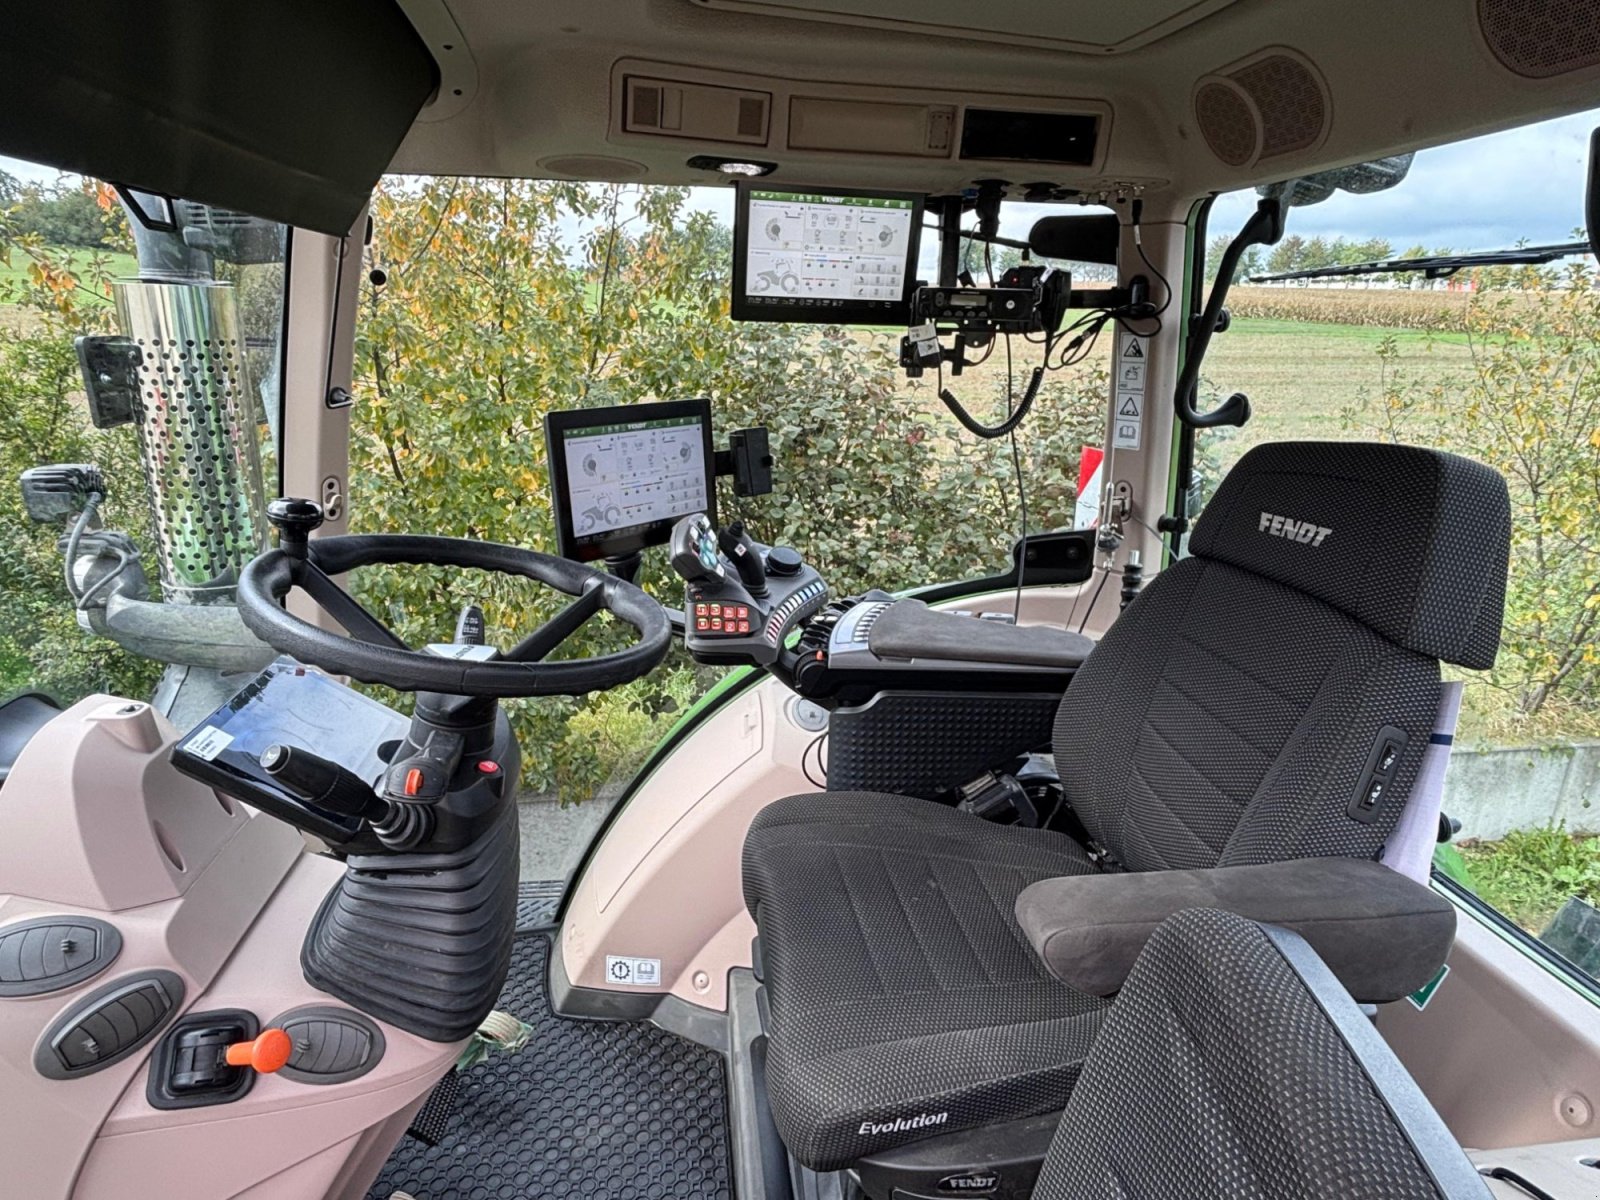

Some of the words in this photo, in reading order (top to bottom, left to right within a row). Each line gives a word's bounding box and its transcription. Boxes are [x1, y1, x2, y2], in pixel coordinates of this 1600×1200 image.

[1258, 511, 1333, 547] FENDT
[858, 1112, 948, 1135] Evolution
[950, 1177, 996, 1188] FENDT
